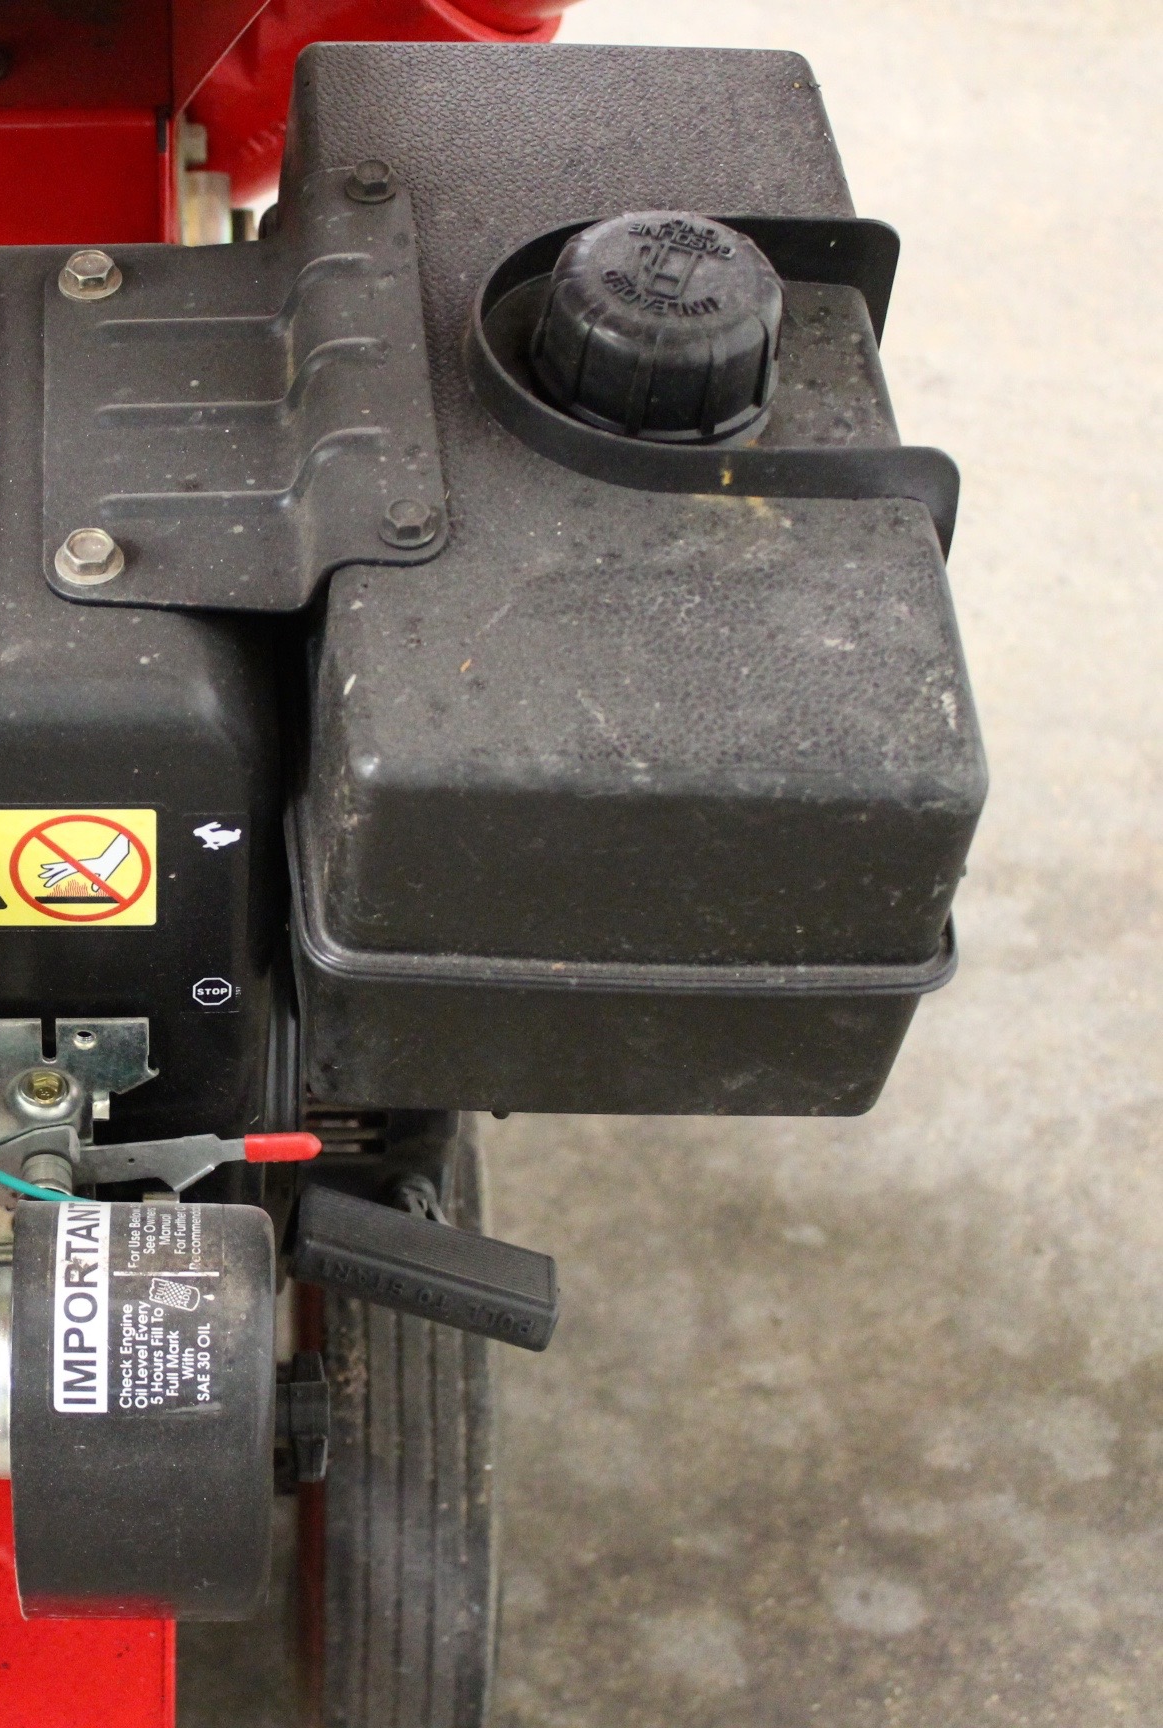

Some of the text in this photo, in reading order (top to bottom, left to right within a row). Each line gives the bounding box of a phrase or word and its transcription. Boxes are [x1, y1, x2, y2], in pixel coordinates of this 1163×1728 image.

[197, 987, 228, 996] STOP
[128, 1229, 141, 1247] Use
[144, 1234, 156, 1254] See
[174, 1239, 186, 1254] For
[128, 1249, 141, 1268] For
[63, 1202, 102, 1405] IMPORTANT
[180, 1288, 192, 1308] ADD
[119, 1303, 135, 1408] Check Engine
[134, 1301, 151, 1408] Oil Level Every
[150, 1307, 164, 1405] 5 Hours Fill To
[166, 1330, 180, 1396] Full Mark
[181, 1348, 194, 1379] With
[198, 1323, 210, 1401] SAE 30 OIL
